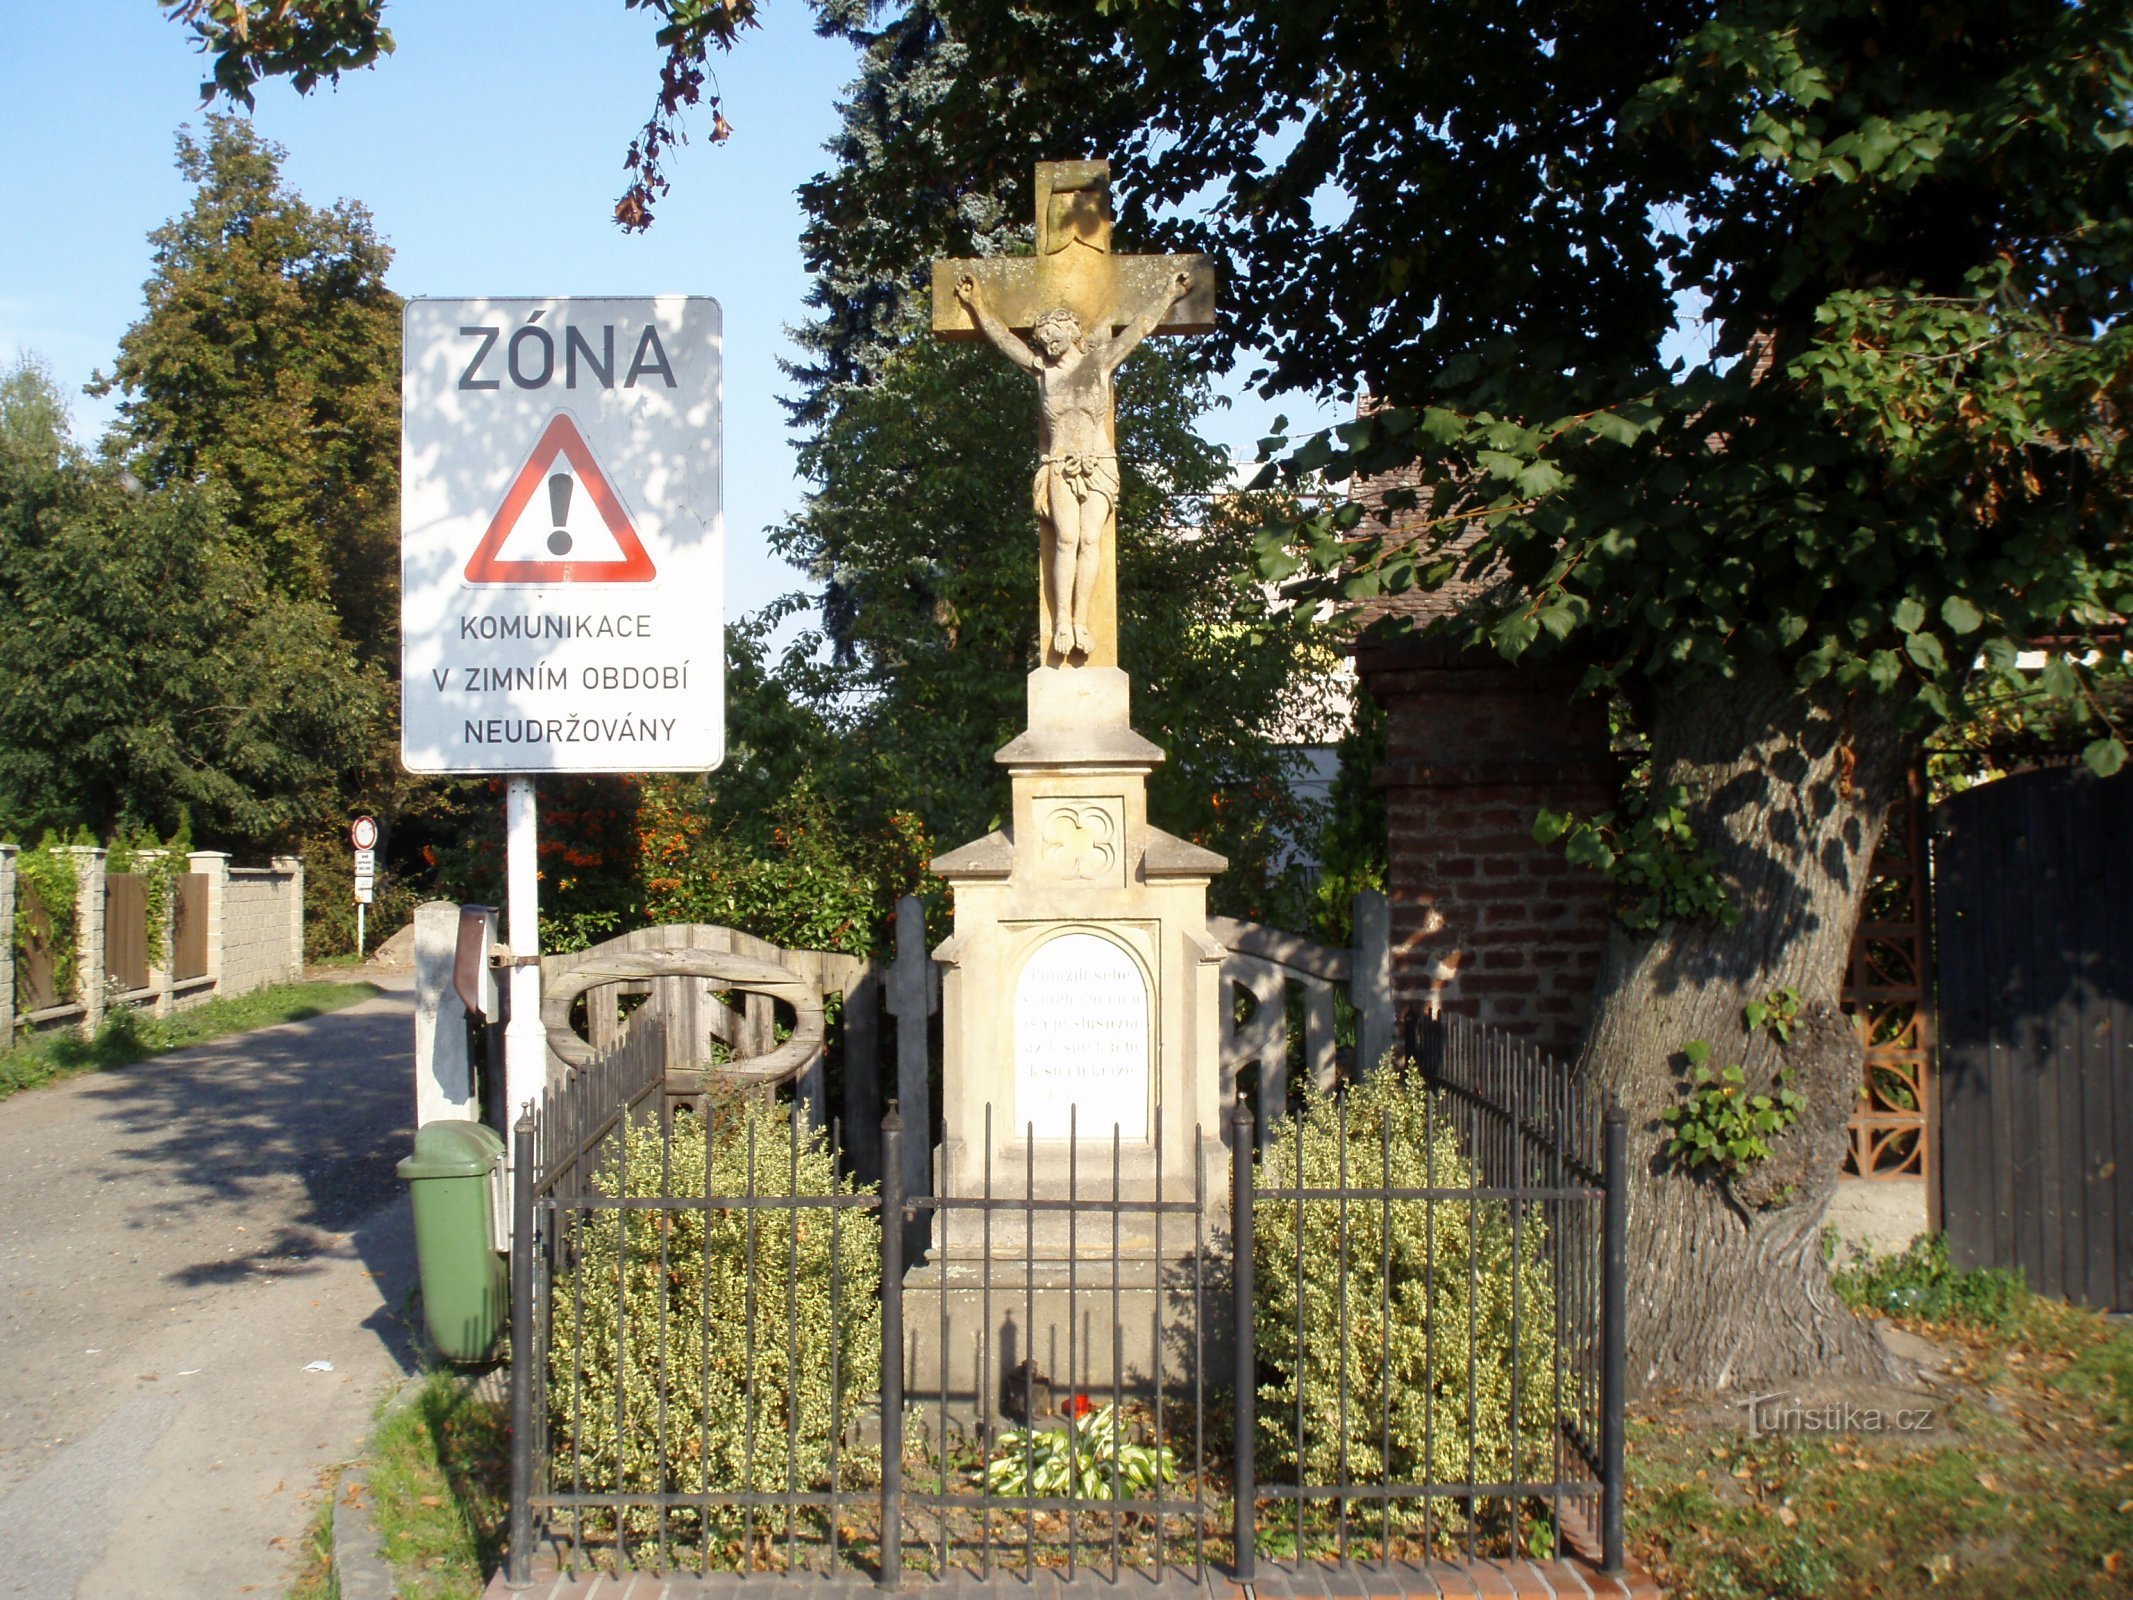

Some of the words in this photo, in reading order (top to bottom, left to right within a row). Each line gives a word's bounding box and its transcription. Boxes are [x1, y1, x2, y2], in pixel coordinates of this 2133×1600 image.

[458, 310, 678, 391] ZÓNA
[460, 614, 652, 641] KOMUNIKACE
[432, 668, 450, 692] V
[465, 661, 567, 692] ZIMNÍM
[582, 659, 688, 690] OBDOBÍ
[464, 712, 677, 744] NEUDRŽOVÁNY
